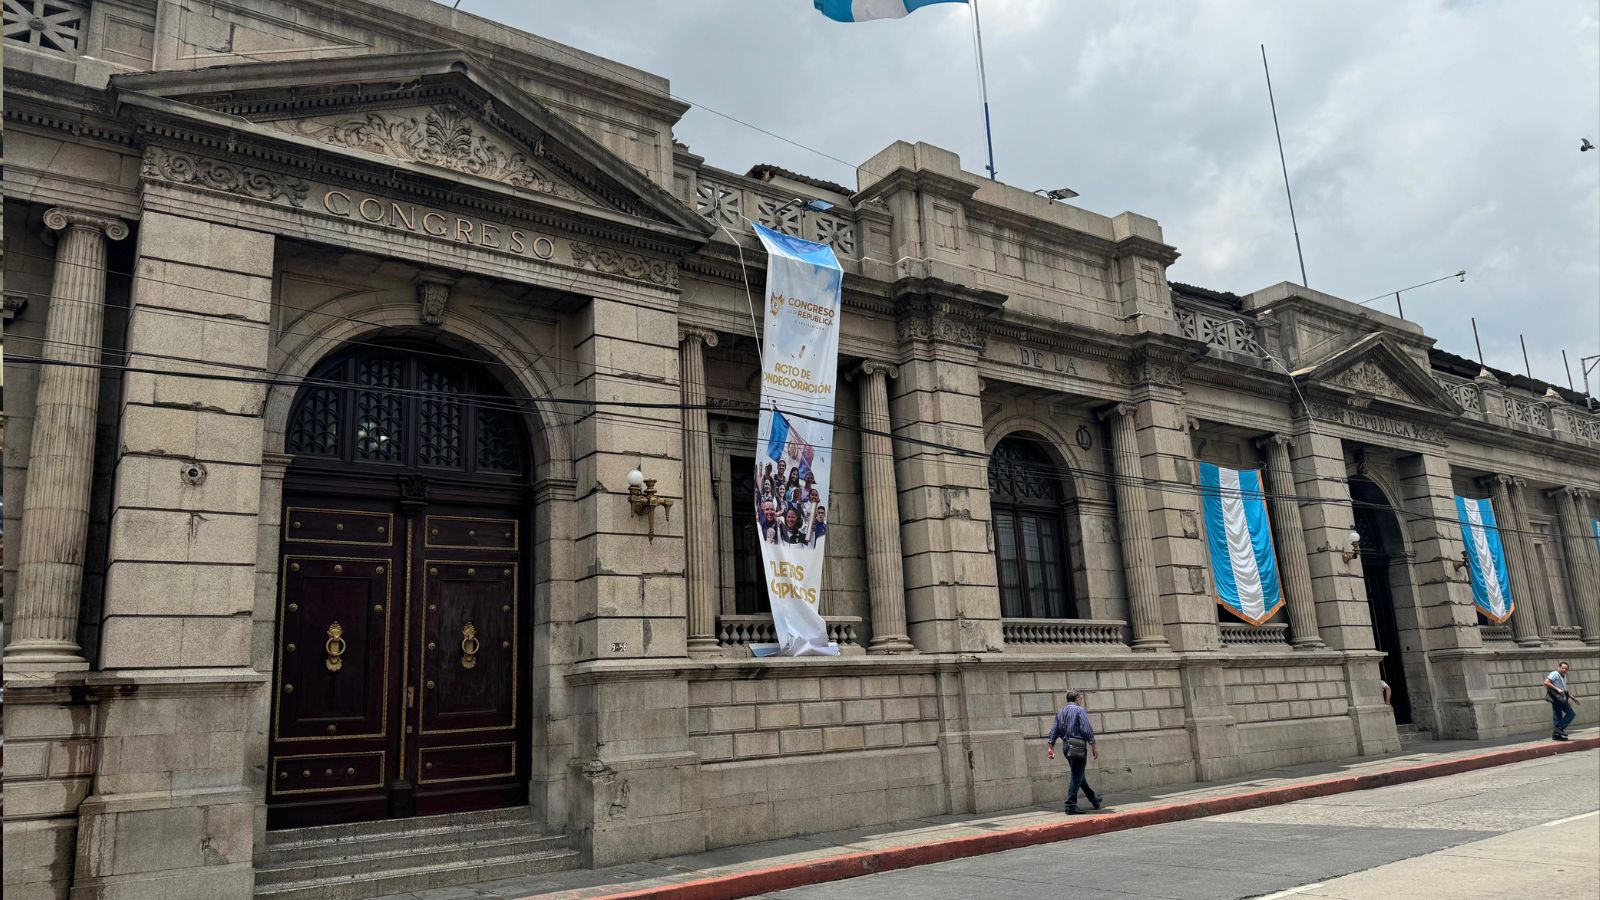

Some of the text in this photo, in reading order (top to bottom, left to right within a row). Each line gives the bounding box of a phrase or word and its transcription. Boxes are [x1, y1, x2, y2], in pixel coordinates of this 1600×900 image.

[323, 190, 555, 260] CONGRESO
[788, 297, 835, 318] CONGRESO
[774, 362, 812, 380] ACTO DE
[1019, 346, 1079, 376] DE LA
